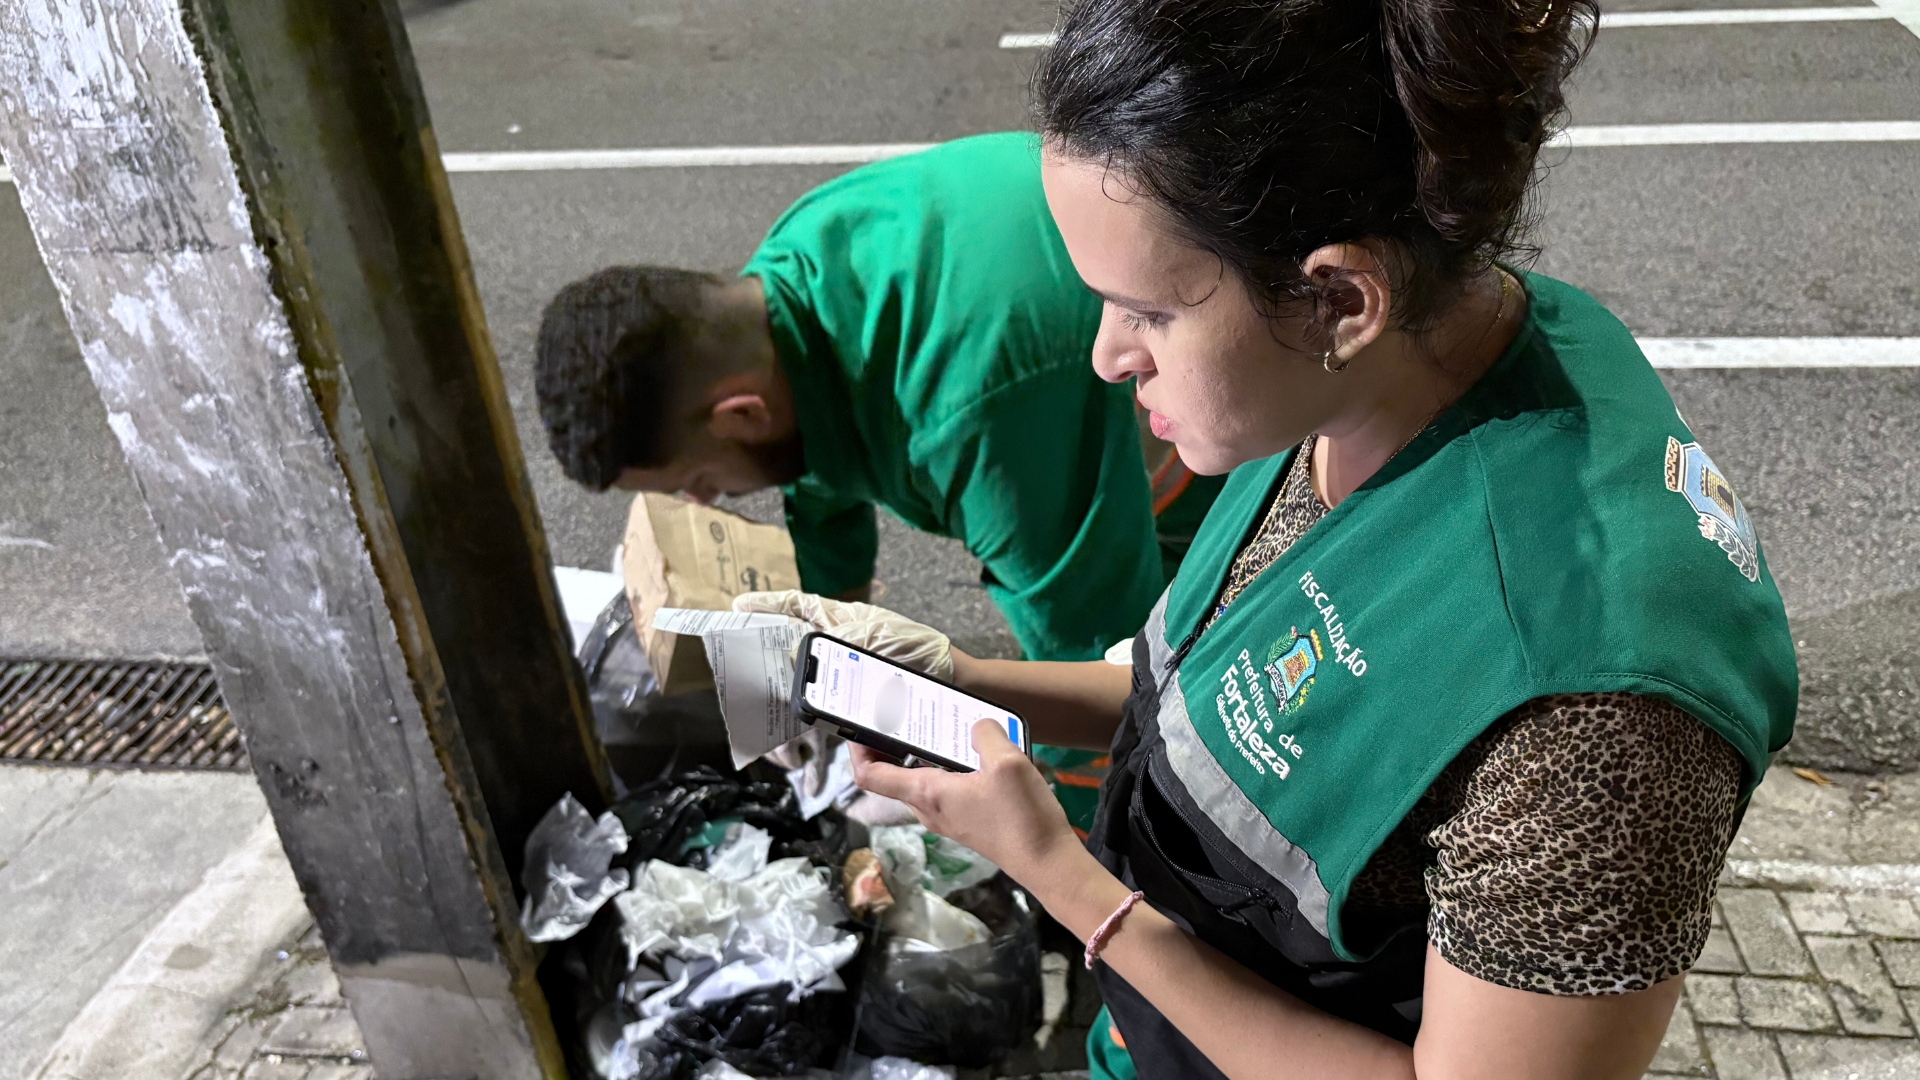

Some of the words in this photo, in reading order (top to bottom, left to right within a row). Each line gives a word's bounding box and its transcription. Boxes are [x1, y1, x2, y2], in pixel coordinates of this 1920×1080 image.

[1298, 570, 1367, 677] FISCALIZAÇÃO
[1220, 663, 1291, 780] Fortaleza
[1234, 740, 1265, 775] Prefeito
[1237, 648, 1274, 733] Prefeitura
[1278, 733, 1303, 759] de
